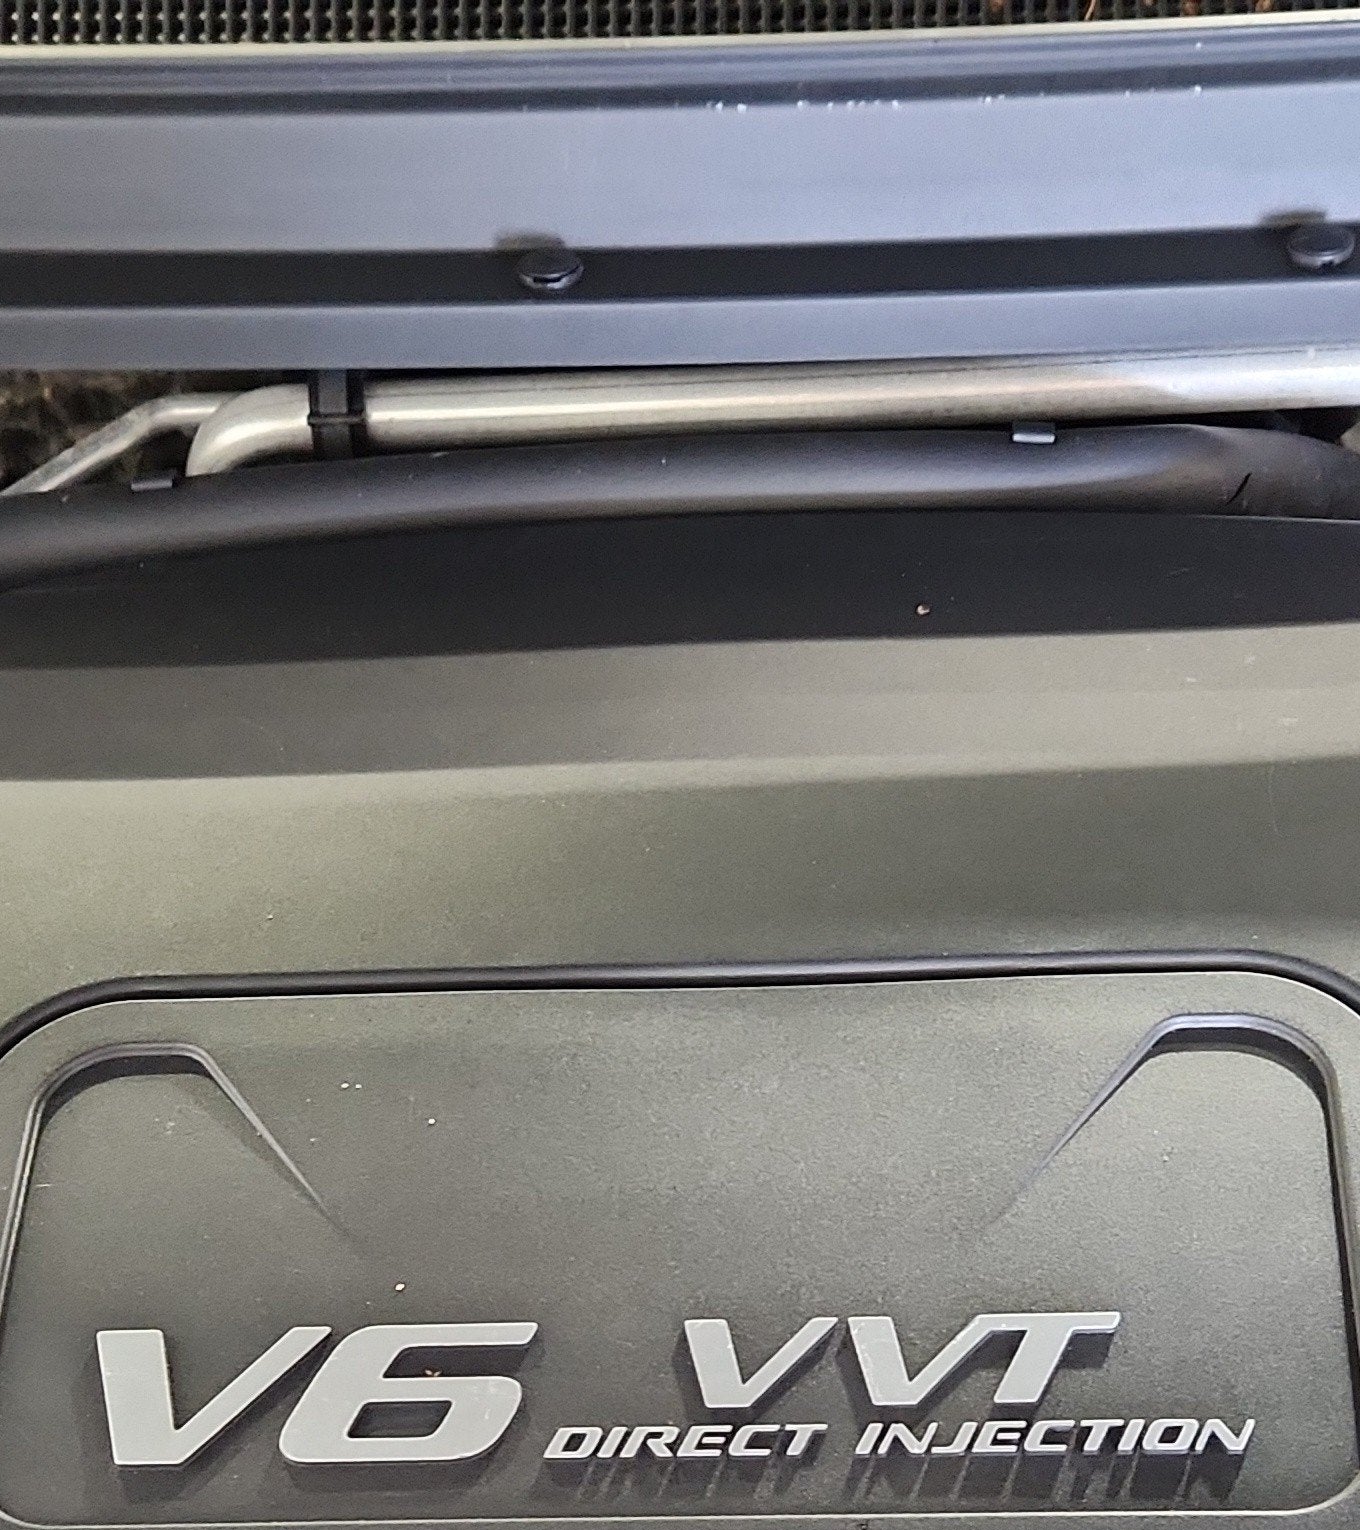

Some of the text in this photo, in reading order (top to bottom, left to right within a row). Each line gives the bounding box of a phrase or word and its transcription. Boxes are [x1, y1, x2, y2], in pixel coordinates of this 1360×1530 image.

[96, 1310, 1121, 1466] V6 VVT
[544, 1417, 1257, 1461] DIRECT INJECTION
